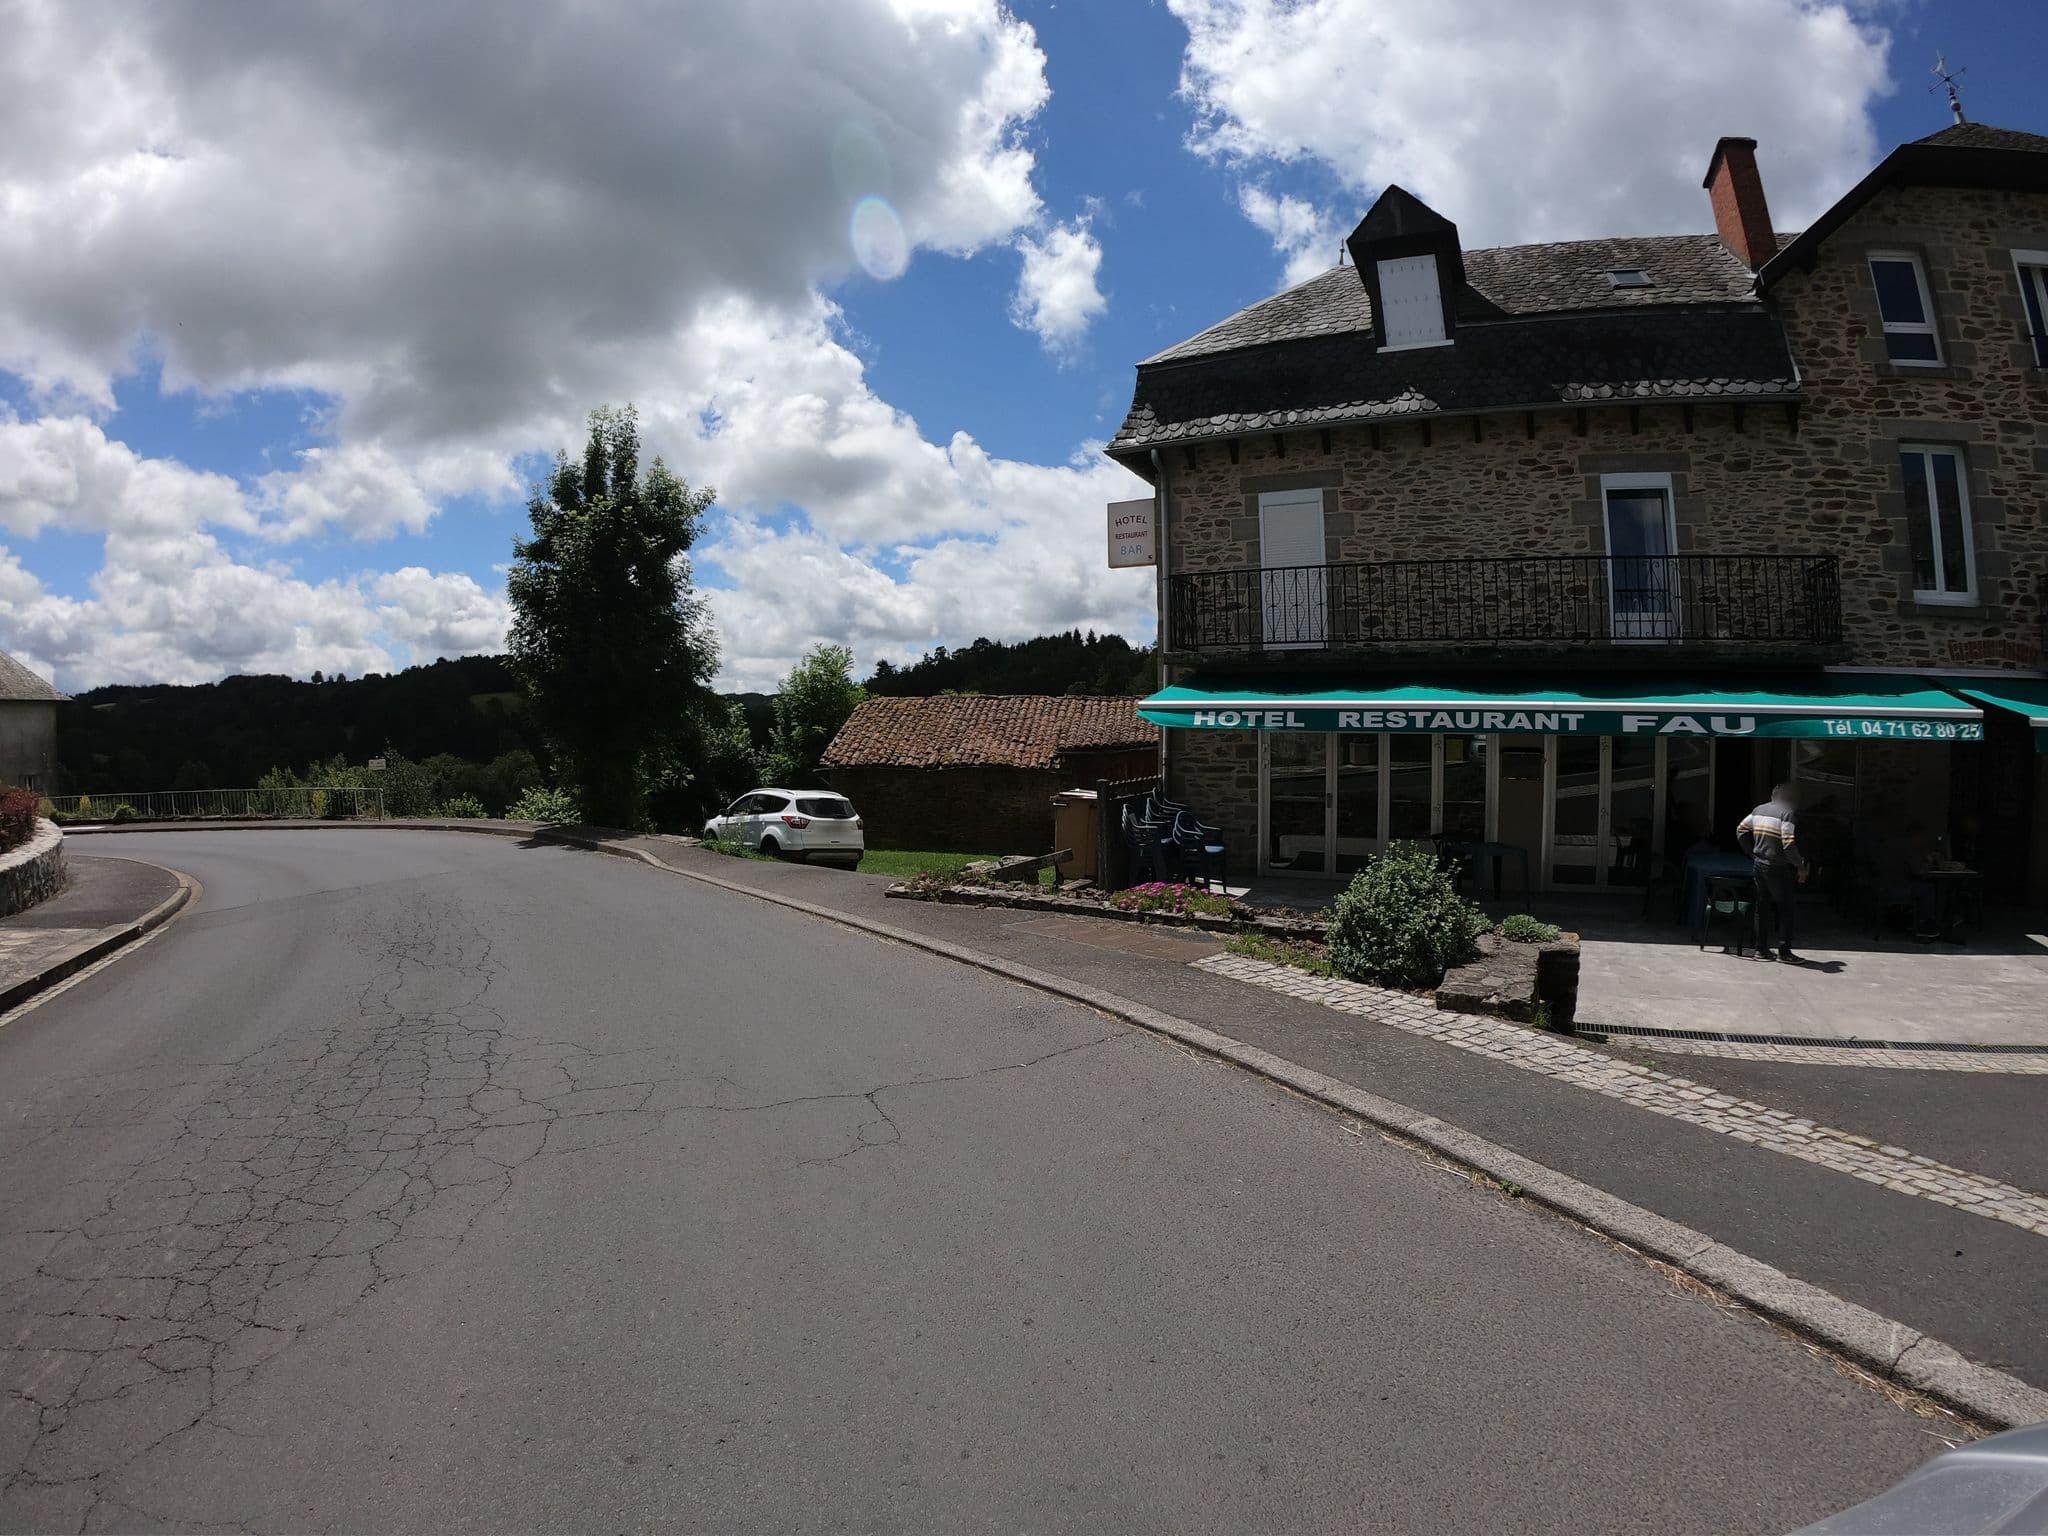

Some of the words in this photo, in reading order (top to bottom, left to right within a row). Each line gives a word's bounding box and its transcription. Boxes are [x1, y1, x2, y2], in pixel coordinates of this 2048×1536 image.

[1115, 515, 1147, 527] HOTEL
[1115, 530, 1148, 540] RESTAURANT
[1121, 544, 1143, 555] BAR
[1193, 711, 1305, 728] HOTEL
[1338, 711, 1585, 731] RESTAURANT
[1622, 714, 1756, 735] FAU
[1823, 720, 1857, 735] Tél.
[1861, 721, 1884, 735] 04
[1886, 722, 1907, 737] 71
[1911, 723, 1932, 738] 62
[1935, 723, 1956, 738] 80
